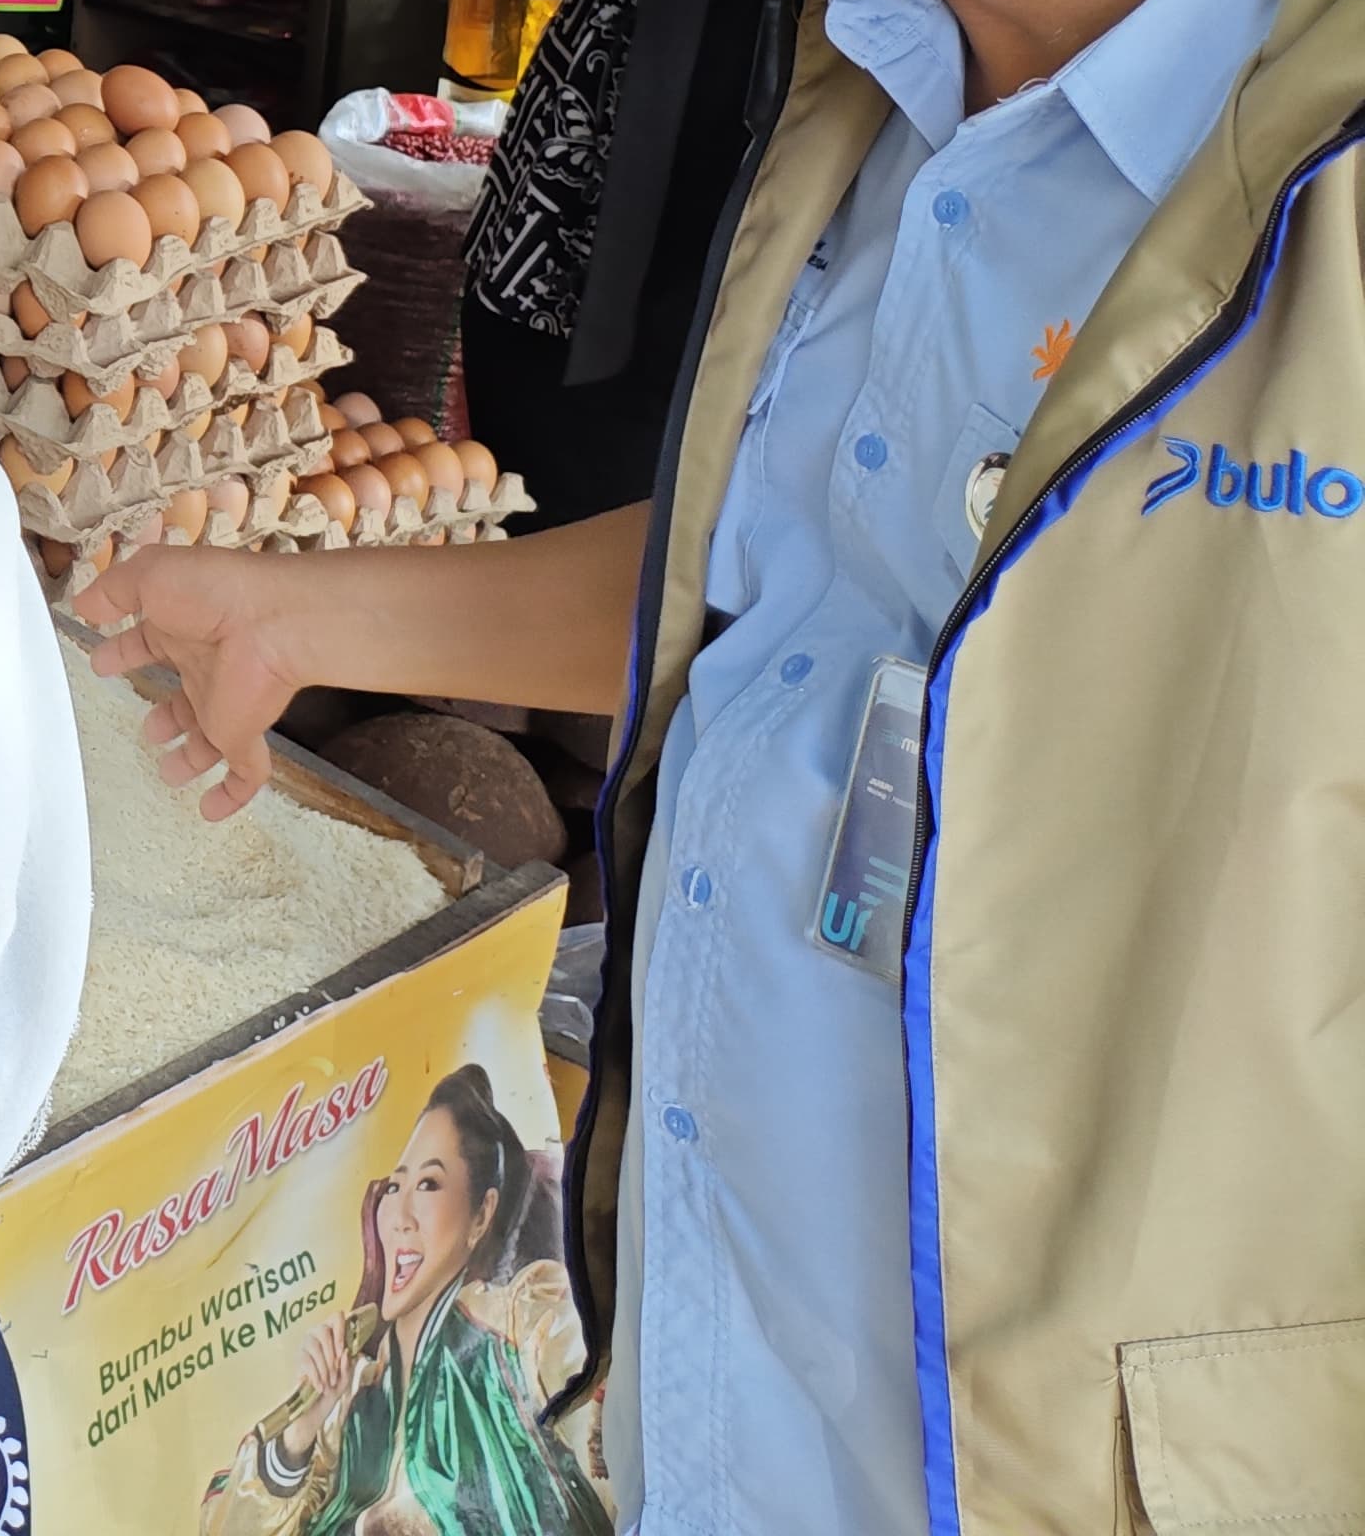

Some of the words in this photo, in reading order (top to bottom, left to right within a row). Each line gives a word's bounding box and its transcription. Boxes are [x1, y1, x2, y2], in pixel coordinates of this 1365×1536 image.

[1205, 441, 1364, 519] bulo
[62, 1171, 226, 1314] Rasa
[224, 1056, 390, 1207] Masa
[86, 1385, 140, 1449] dari
[142, 1349, 216, 1409] Masa
[221, 1321, 256, 1353] ke
[266, 1277, 338, 1338] Masa
[100, 1317, 193, 1395] Bumbu
[199, 1248, 317, 1331] Warisan
